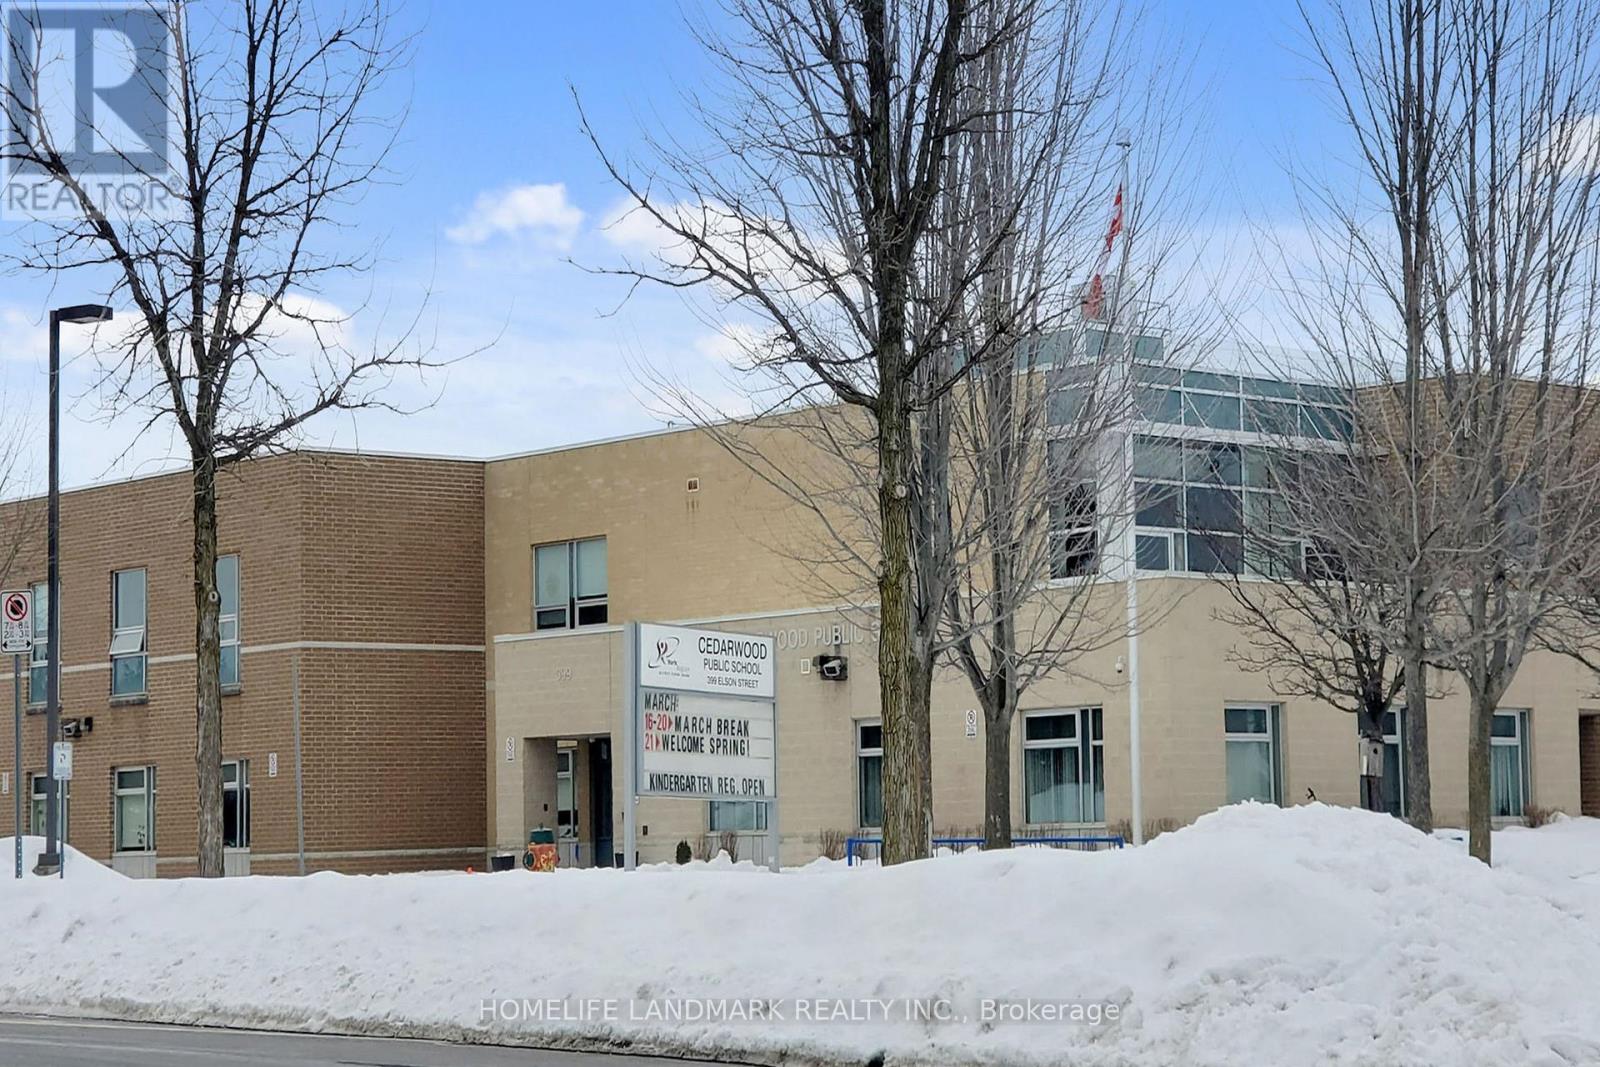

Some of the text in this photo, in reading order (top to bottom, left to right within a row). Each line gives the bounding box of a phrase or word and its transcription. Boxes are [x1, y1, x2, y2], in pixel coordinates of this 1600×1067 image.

[698, 636, 768, 660] CEDARWOOD
[703, 658, 730, 671] PUBLIC
[731, 661, 763, 675] SCHOOL
[718, 677, 737, 687] ELSON
[738, 679, 759, 689] STREET
[674, 715, 713, 735] MARCH
[716, 719, 750, 737] BREAK
[644, 732, 751, 757] 21 WELCOME SPRING!
[649, 773, 765, 796] KINDERGARTEN REG. OPEN
